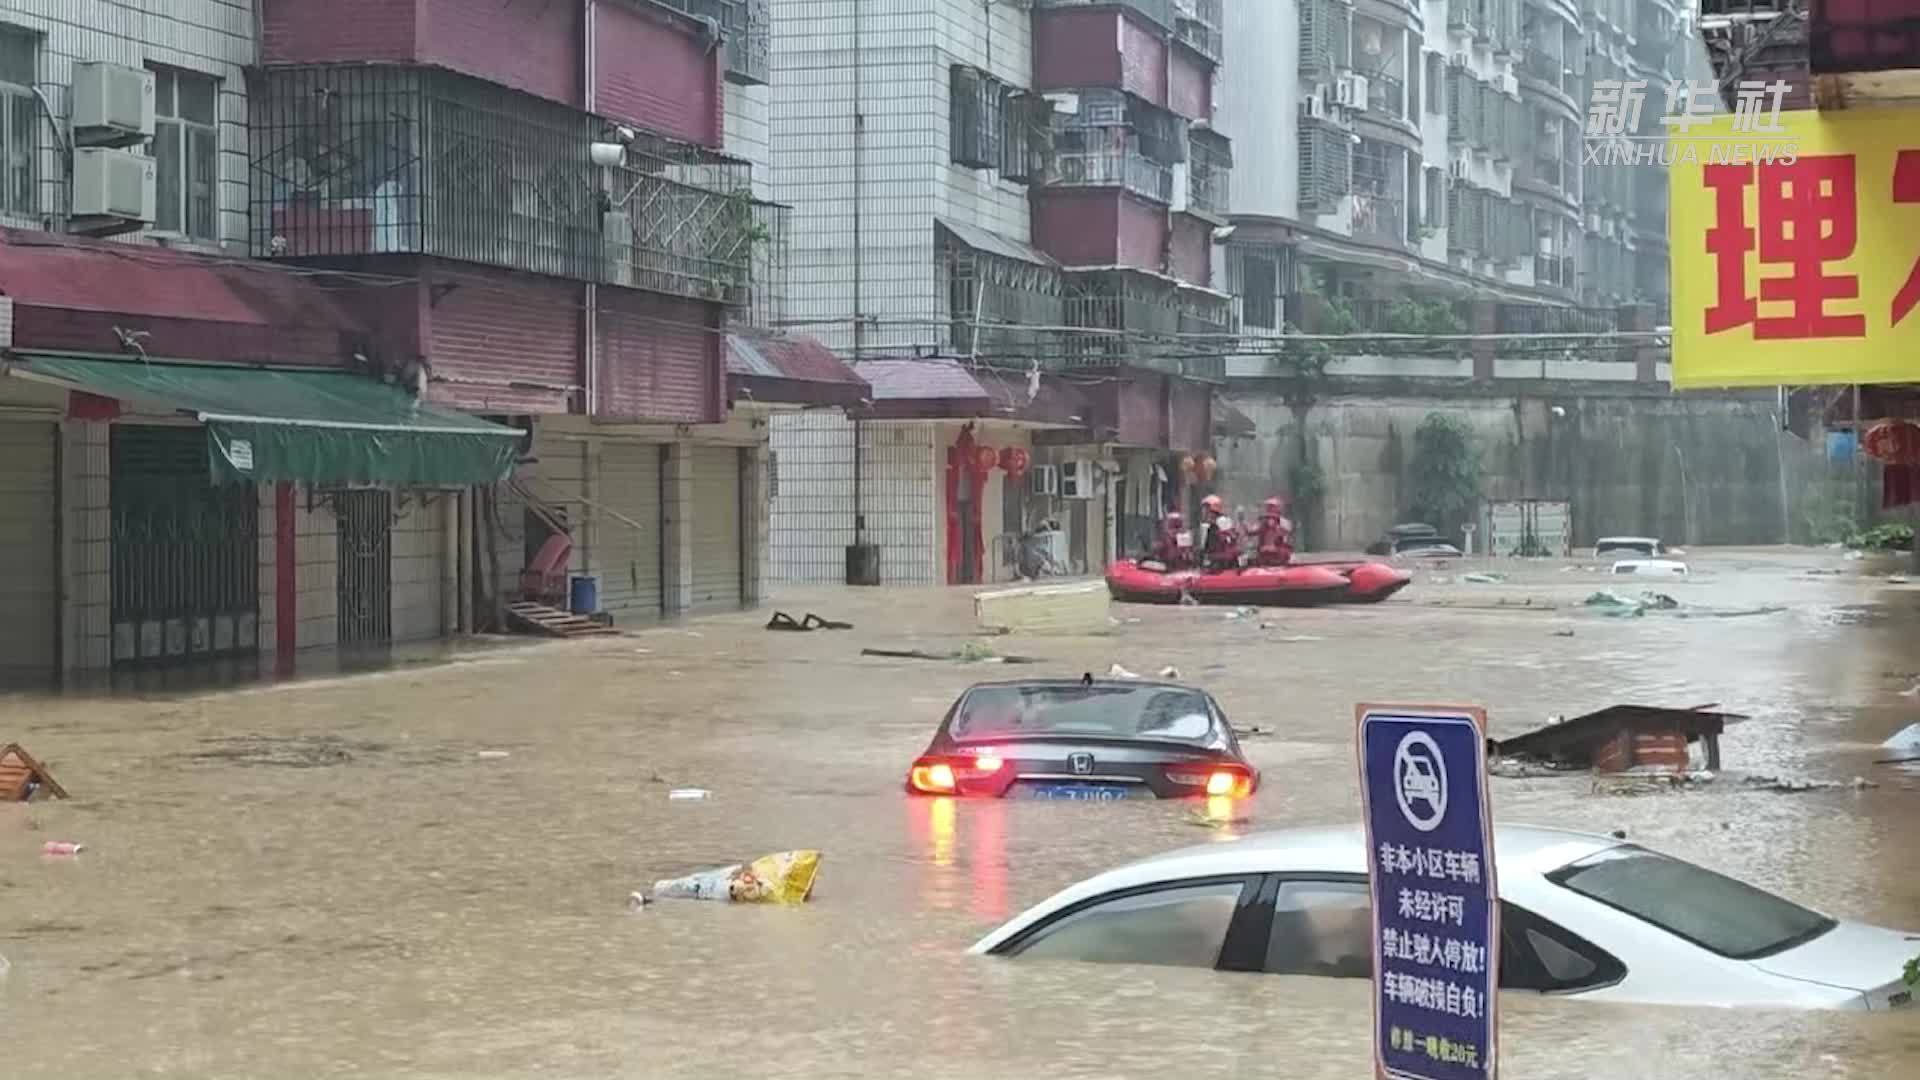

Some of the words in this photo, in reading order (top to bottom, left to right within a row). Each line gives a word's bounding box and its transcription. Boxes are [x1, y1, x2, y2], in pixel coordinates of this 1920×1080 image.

[1703, 149, 1920, 340] 理
[1380, 842, 1480, 884] 非本小区车辆
[1398, 887, 1465, 927] 未经许可
